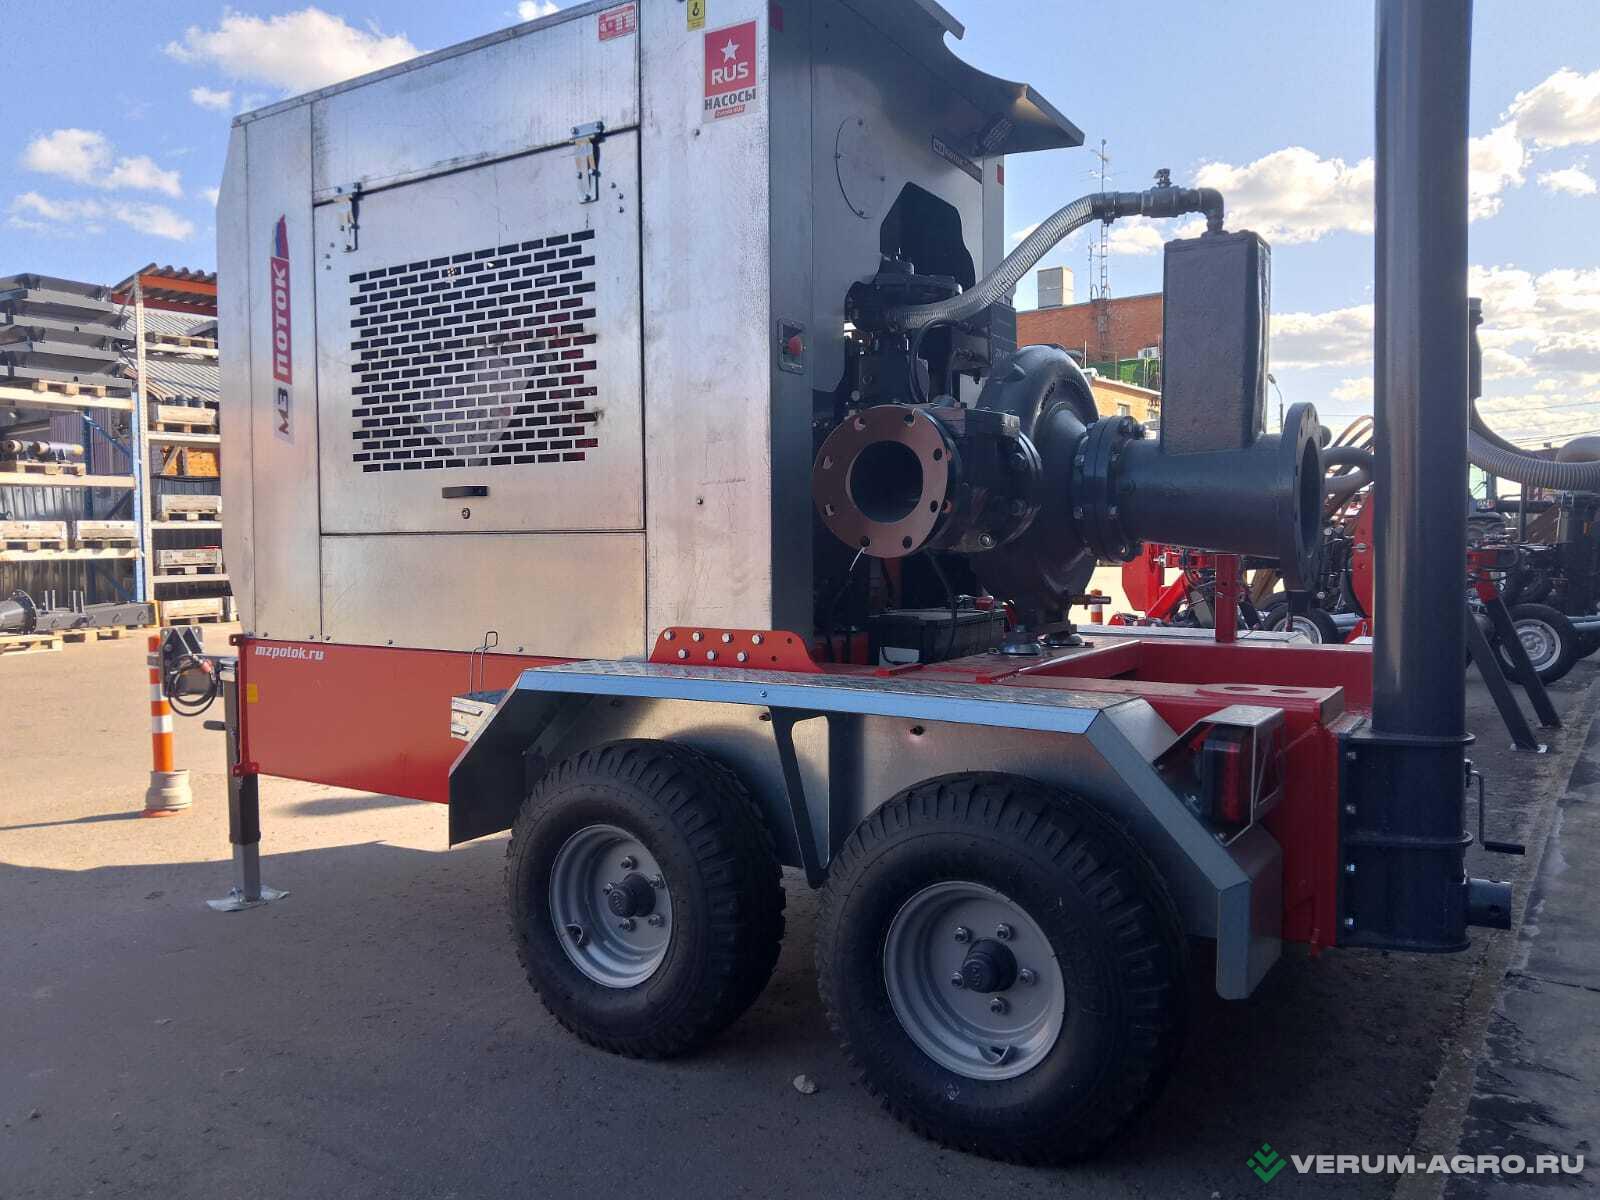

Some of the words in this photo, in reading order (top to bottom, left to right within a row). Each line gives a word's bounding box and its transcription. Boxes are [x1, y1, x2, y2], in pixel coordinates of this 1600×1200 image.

[711, 61, 749, 86] RUS
[704, 87, 757, 111] НАСОСЫ
[272, 261, 289, 376] ПОТОК
